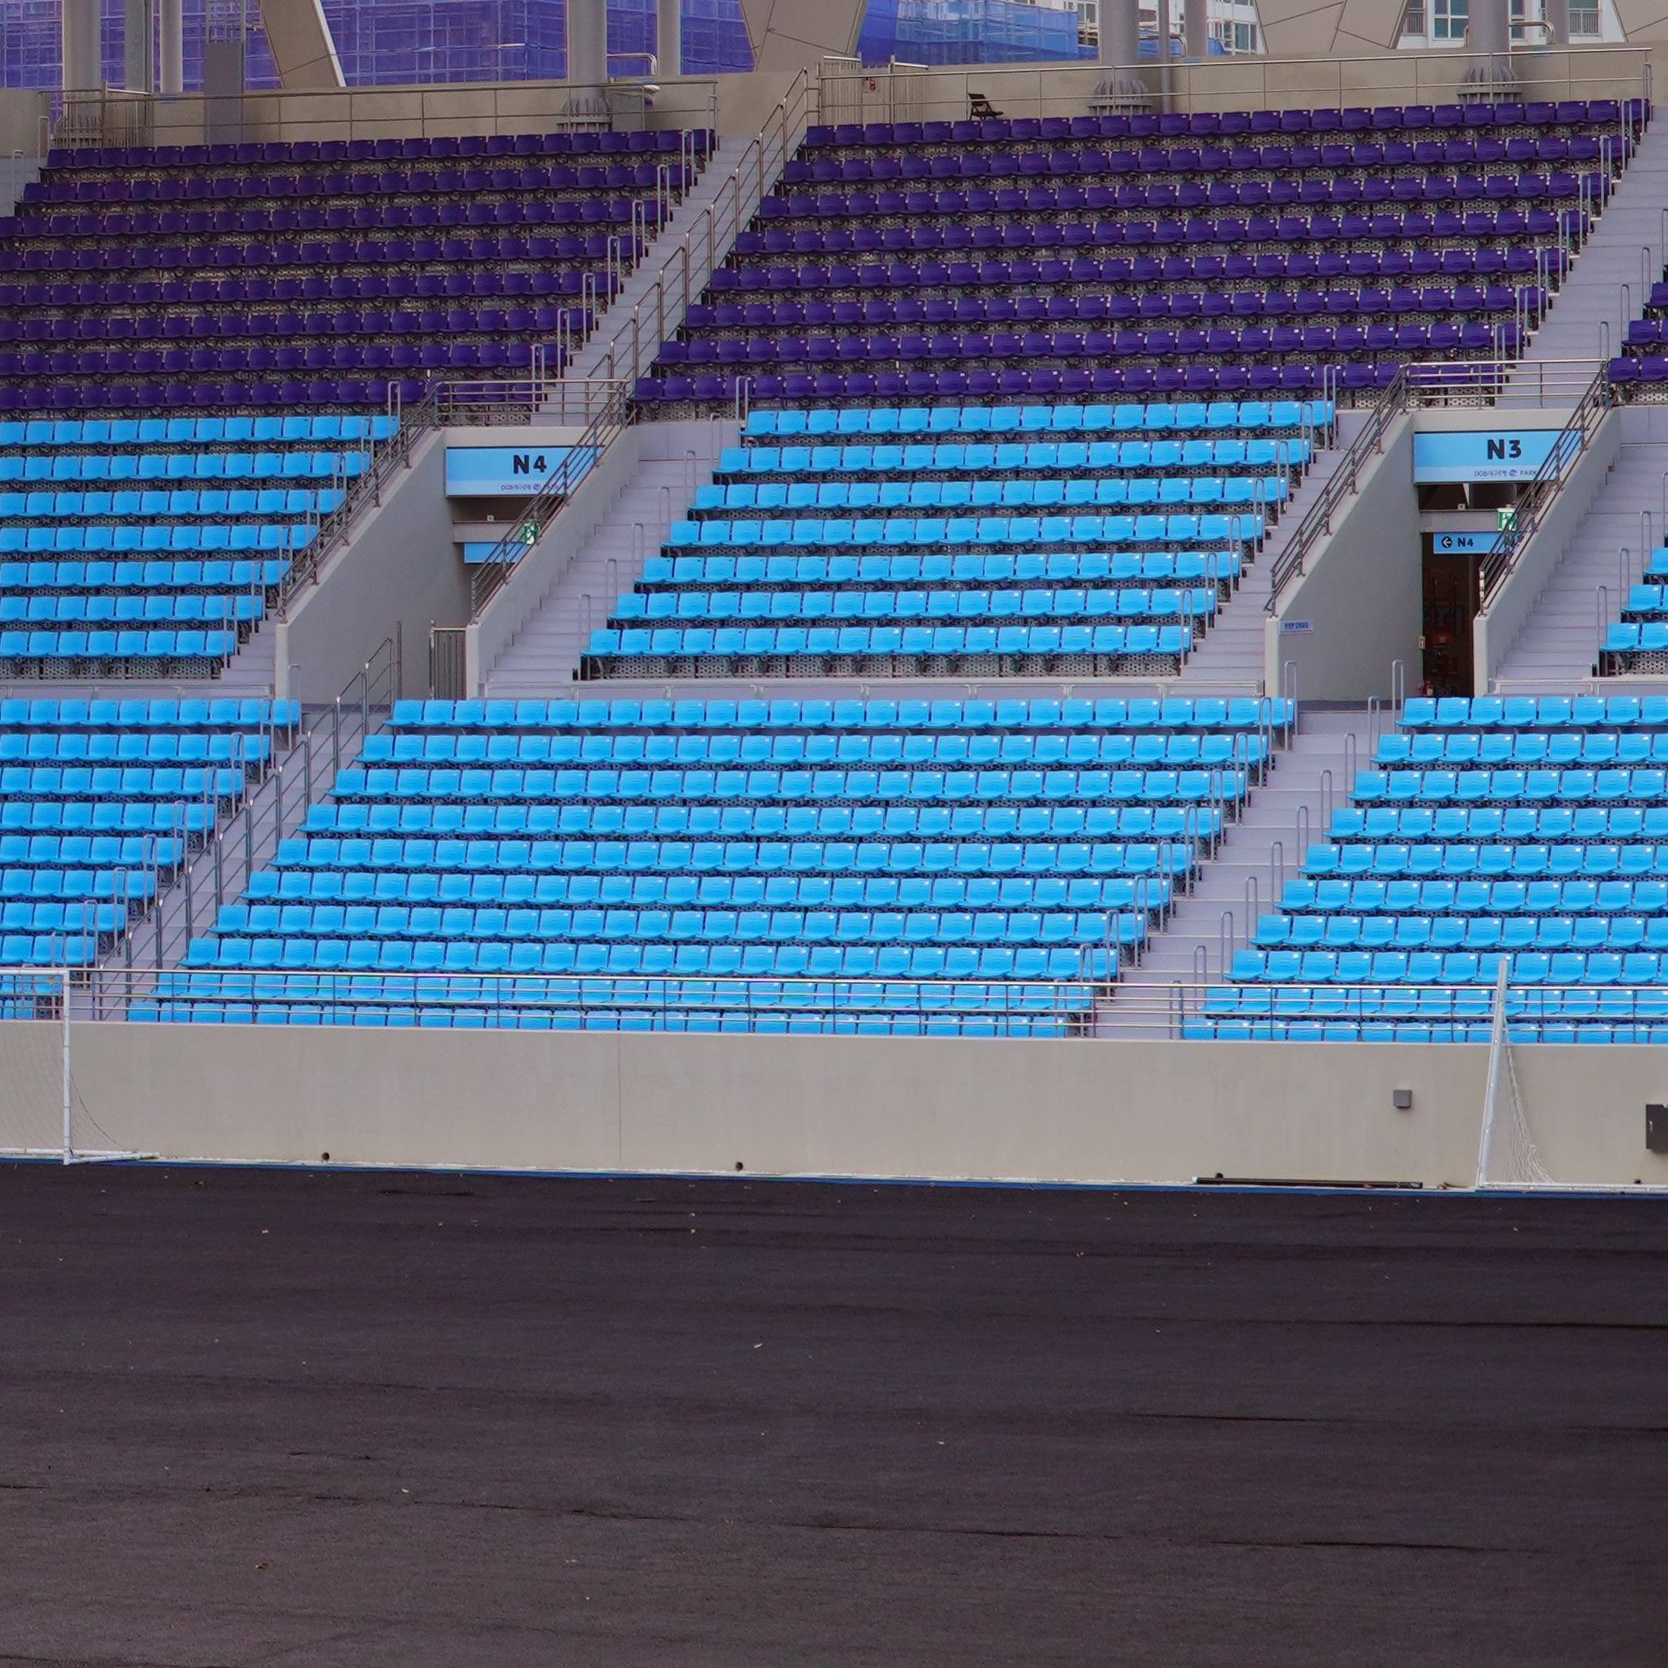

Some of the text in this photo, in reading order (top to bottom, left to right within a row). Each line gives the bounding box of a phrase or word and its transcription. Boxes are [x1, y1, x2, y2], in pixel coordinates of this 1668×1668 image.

[1486, 438, 1522, 460] N3
[513, 454, 547, 474] N4
[1457, 537, 1474, 547] N4
